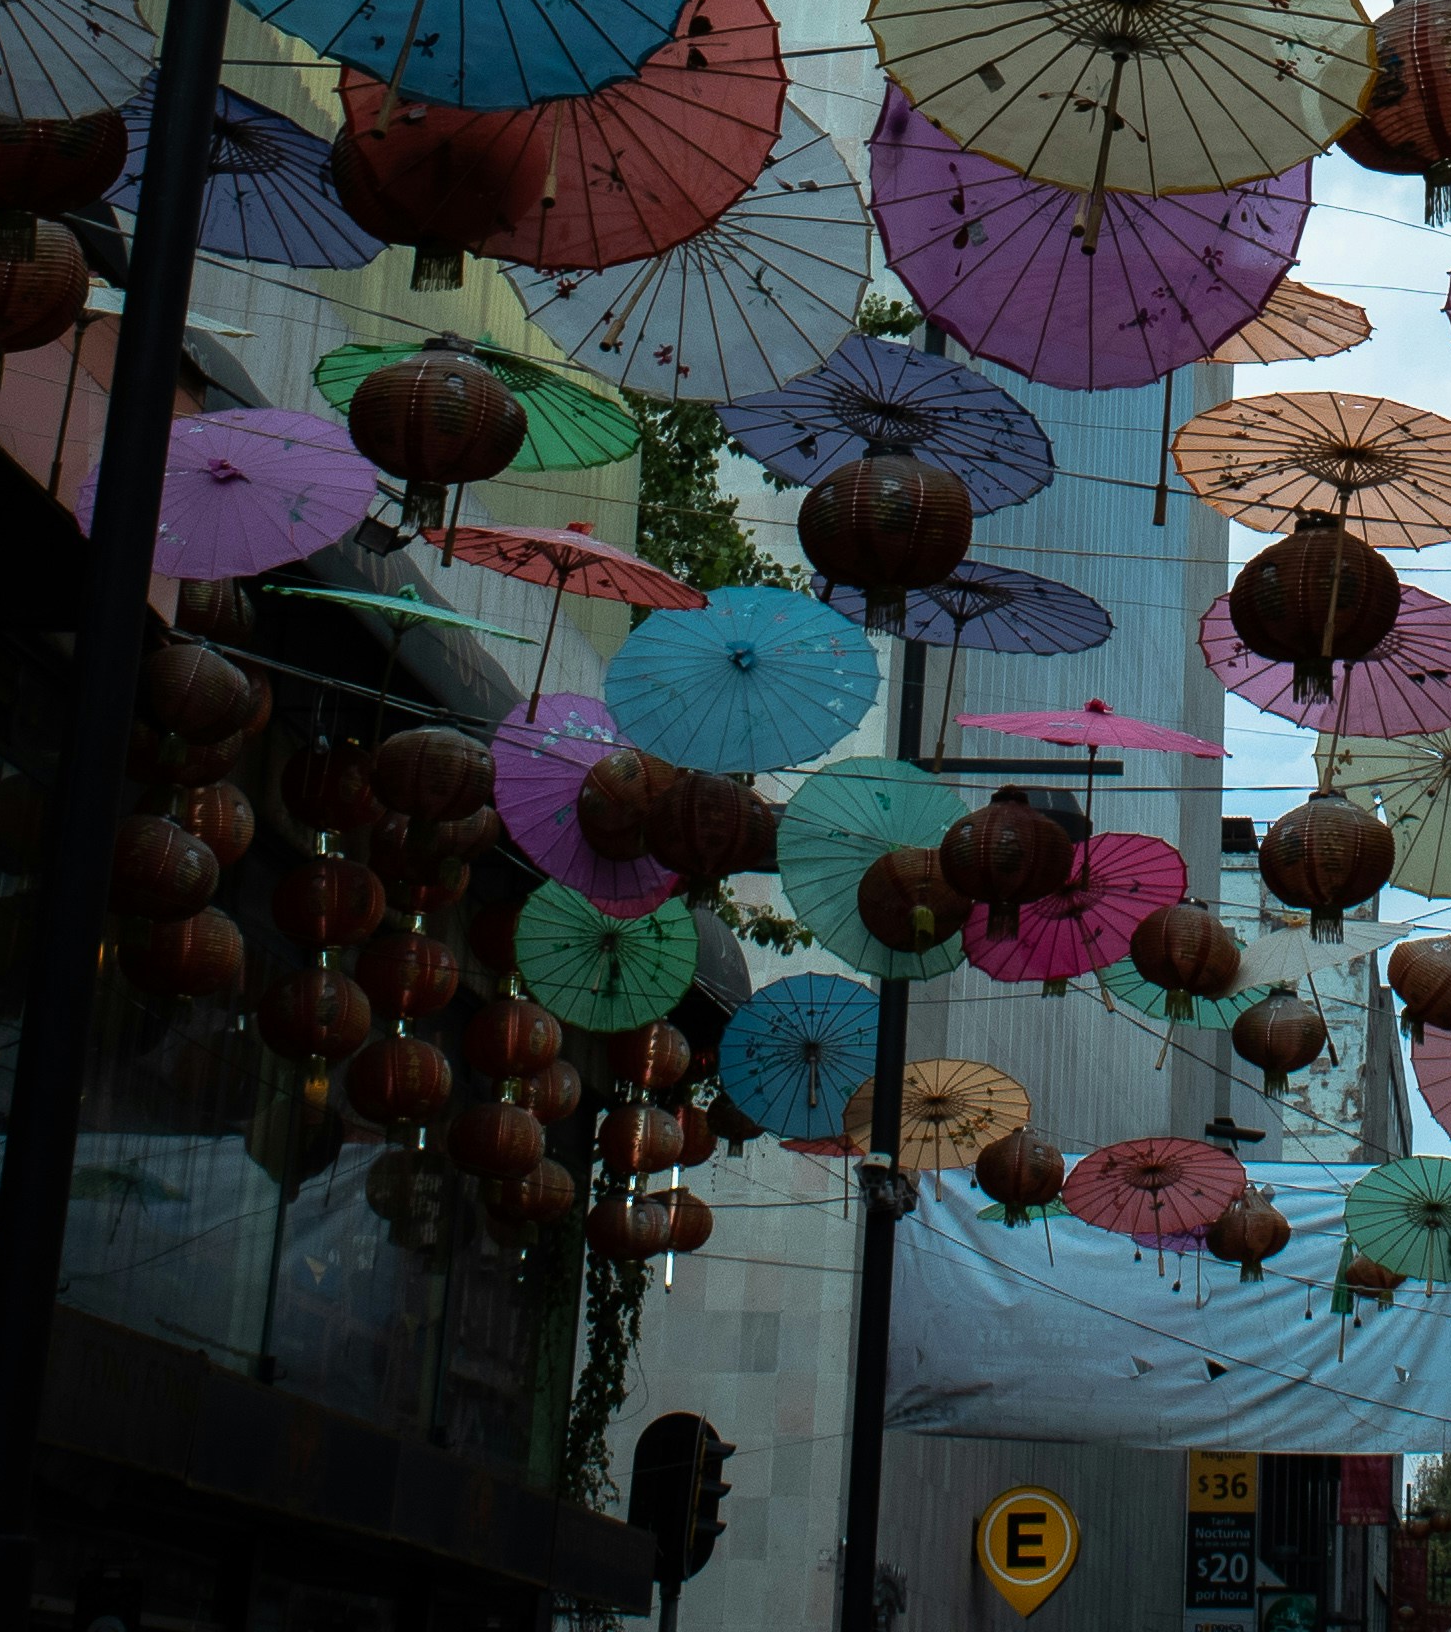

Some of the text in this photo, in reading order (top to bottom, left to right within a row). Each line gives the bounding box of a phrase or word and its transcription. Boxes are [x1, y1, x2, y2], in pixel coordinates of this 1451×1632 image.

[1006, 1512, 1047, 1568] E
[1195, 1527, 1251, 1540] Nocturna
[1197, 1552, 1249, 1584] $20
[1195, 1589, 1248, 1603] por hora
